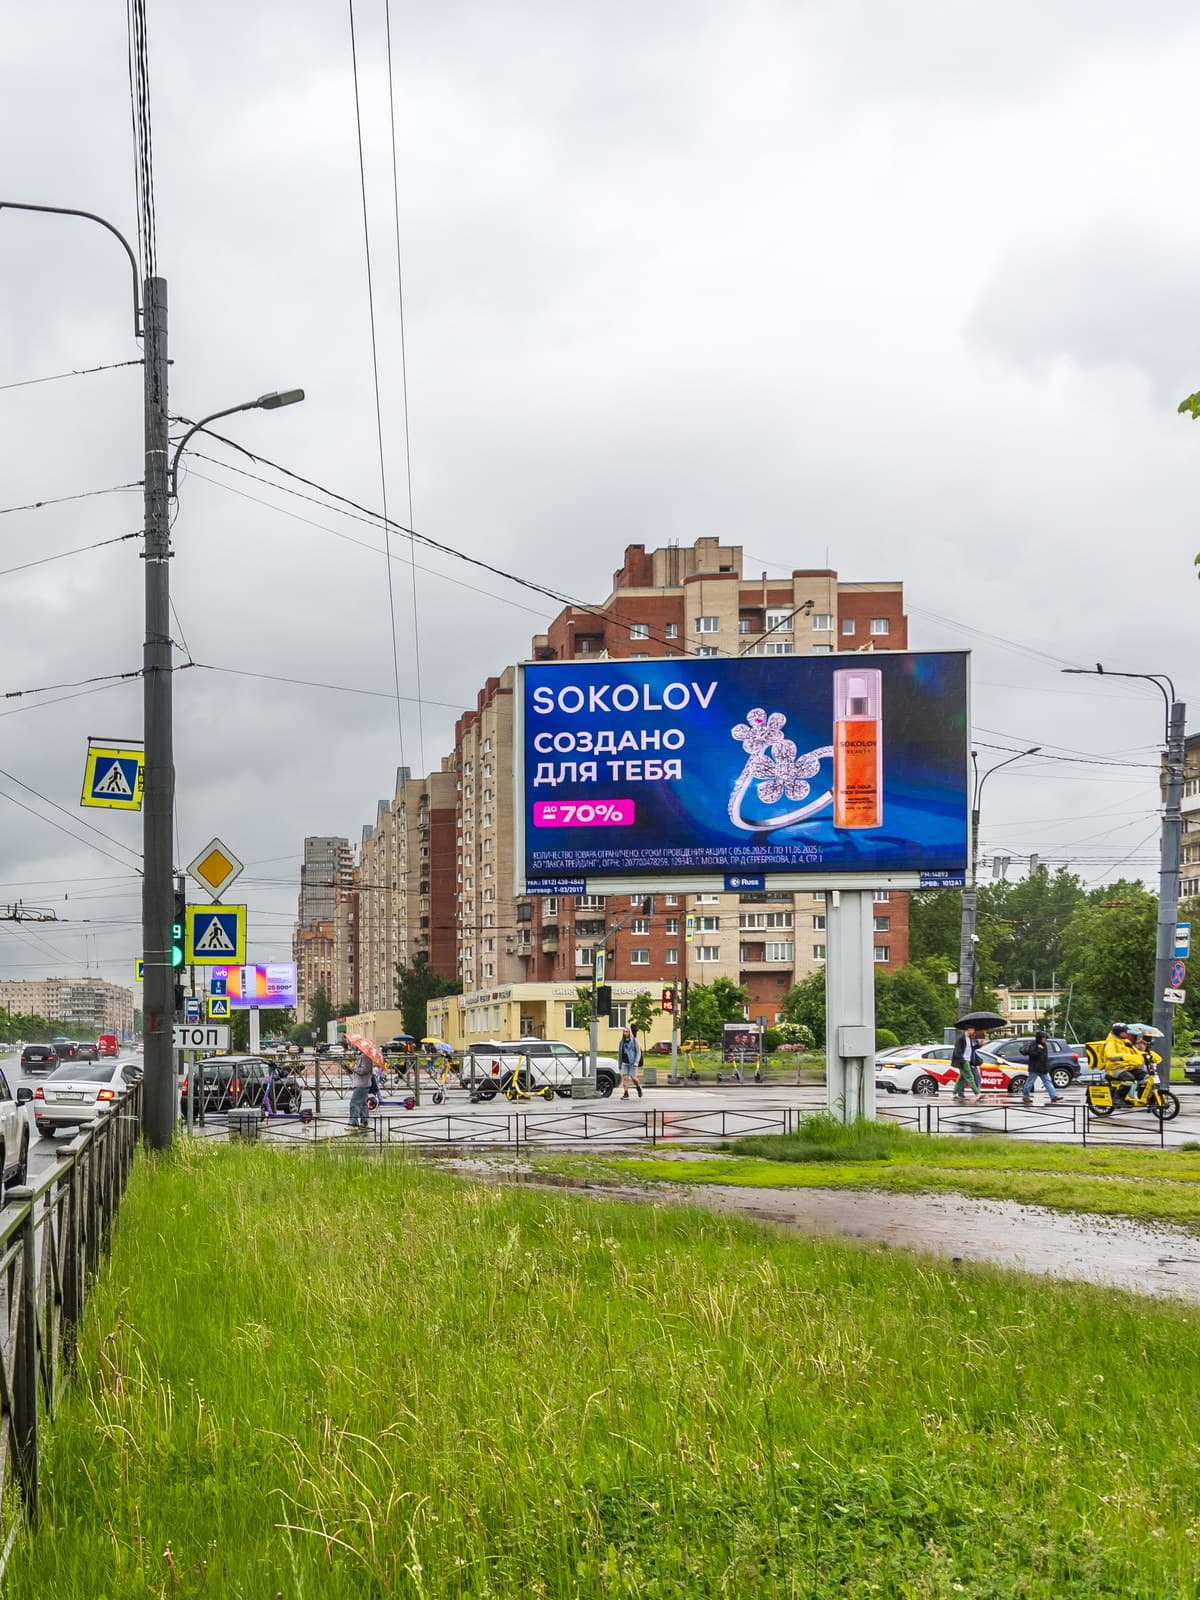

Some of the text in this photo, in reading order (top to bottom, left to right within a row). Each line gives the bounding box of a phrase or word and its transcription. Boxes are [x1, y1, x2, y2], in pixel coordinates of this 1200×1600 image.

[533, 681, 718, 714] SOKOLOV
[534, 728, 685, 755] СОЗДАНО
[533, 759, 683, 787] ДЛЯ ТЕБЯ
[533, 850, 573, 860] КОЛИЧЕСТВО
[705, 847, 728, 856] АКЦИИ
[741, 878, 760, 886] Russ
[215, 969, 228, 977] wb
[172, 1029, 218, 1045] ТОП
